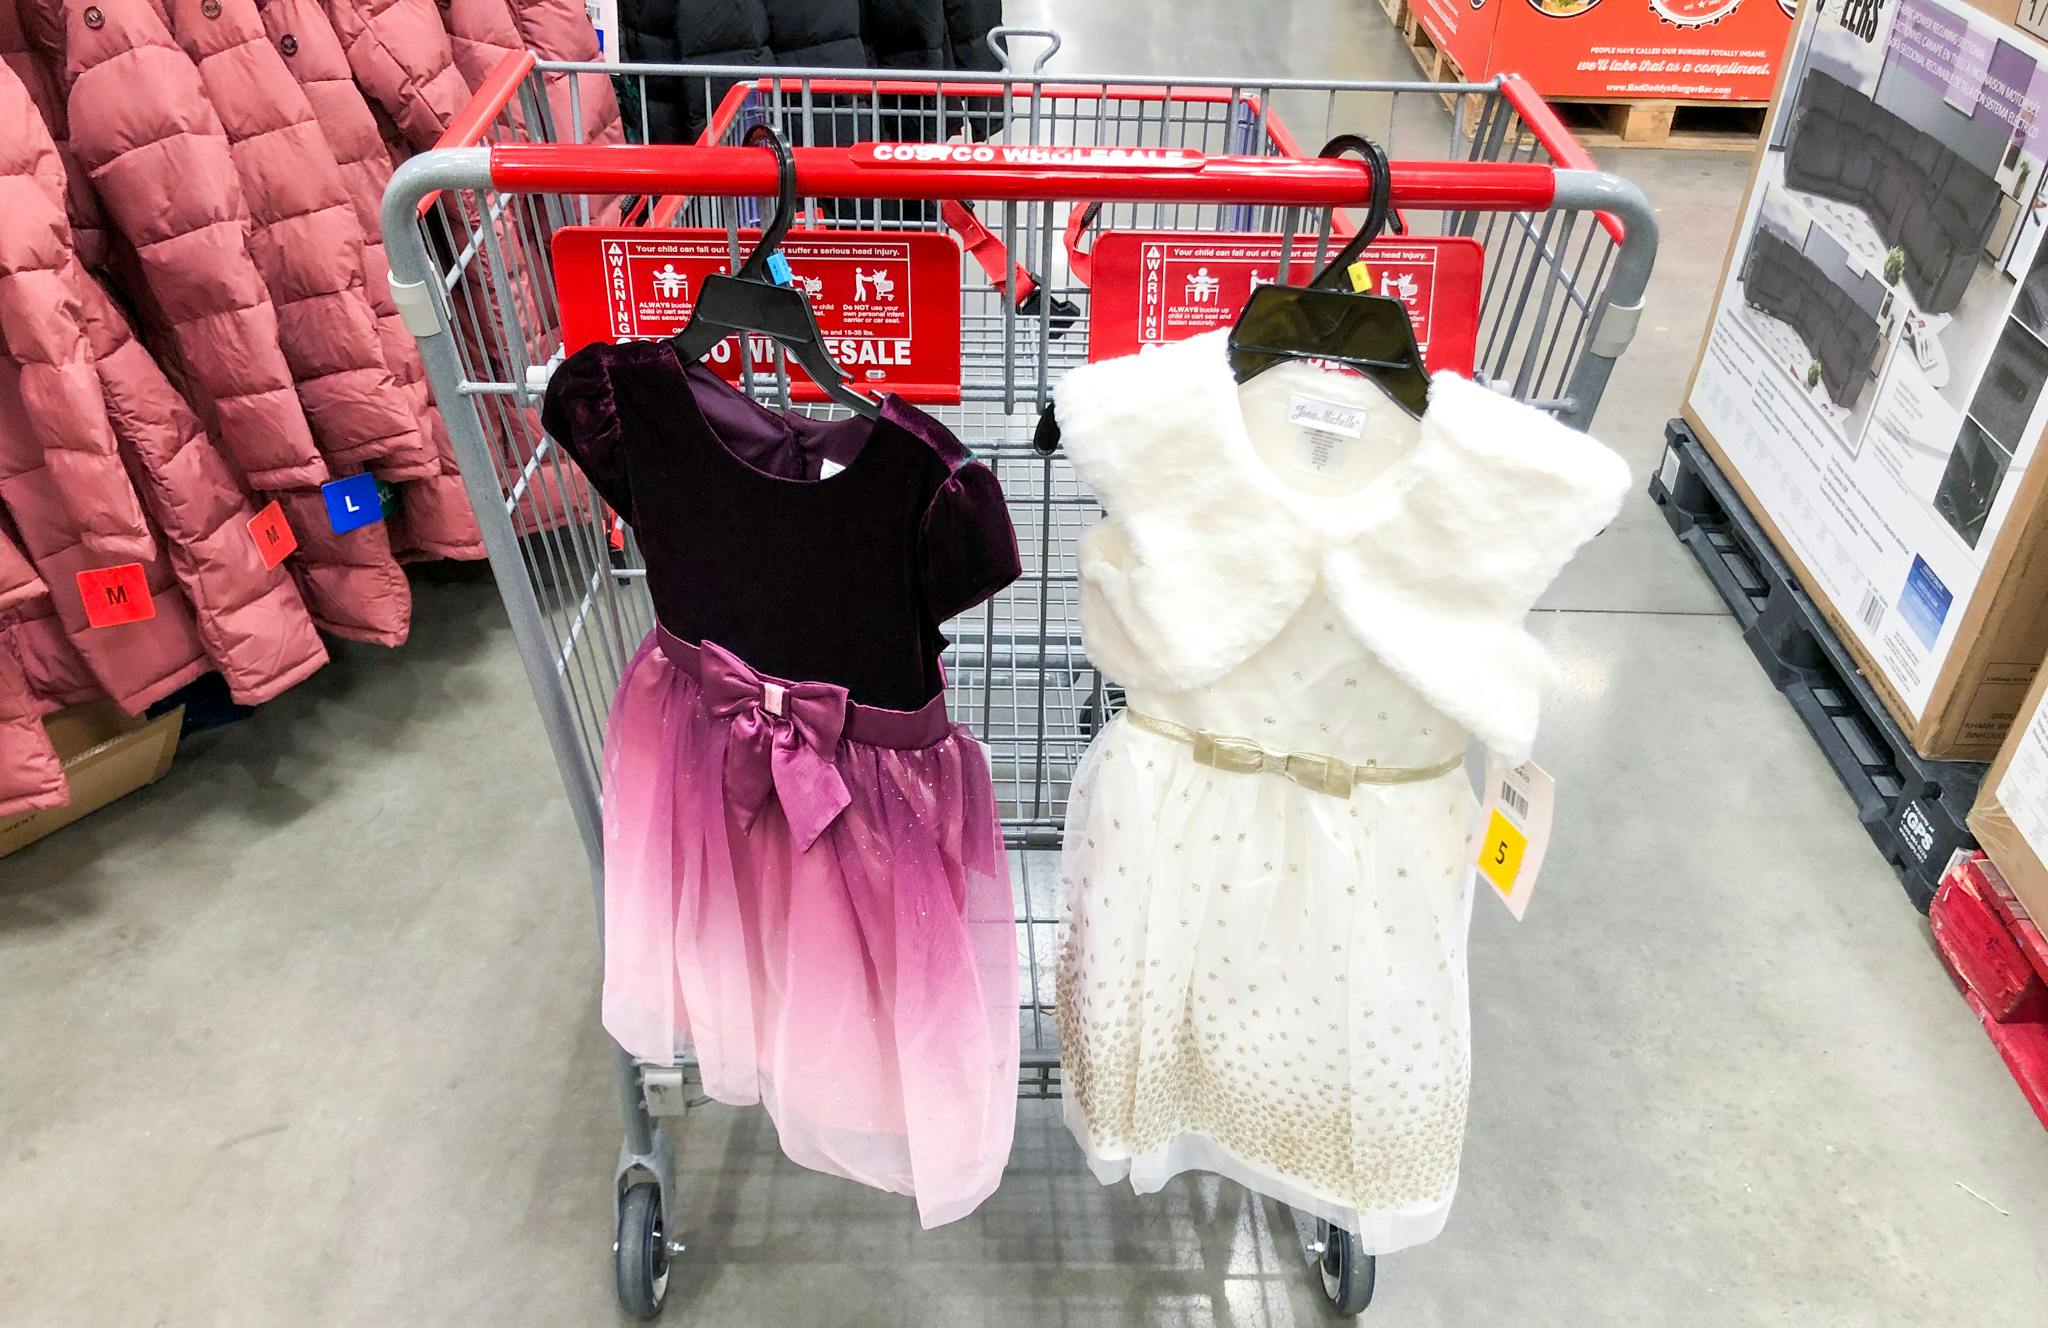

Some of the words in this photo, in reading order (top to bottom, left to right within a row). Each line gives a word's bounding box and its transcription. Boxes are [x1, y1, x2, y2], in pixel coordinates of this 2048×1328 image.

[1616, 47, 1634, 55] HAVE
[1635, 47, 1660, 55] CALLED
[1678, 48, 1709, 56] BURGERS
[1711, 49, 1738, 57] TOTALLY
[1609, 60, 1637, 72] take
[1638, 60, 1665, 73] that
[1665, 63, 1680, 73] as
[1682, 63, 1692, 73] a
[636, 245, 656, 253] Your
[657, 244, 678, 253] child
[696, 245, 709, 253] fall
[787, 246, 811, 254] suffer
[820, 247, 850, 255] serious
[852, 247, 872, 255] head
[874, 247, 900, 256] injury.
[1174, 248, 1194, 256] Your
[1194, 248, 1214, 256] child
[1260, 249, 1270, 257] of
[1402, 251, 1427, 260] injury.
[608, 255, 631, 334] WARNING
[1145, 259, 1161, 339] WARNING
[344, 495, 360, 512] L
[266, 526, 280, 545] M
[106, 586, 128, 605] M
[1495, 840, 1508, 865] 5
